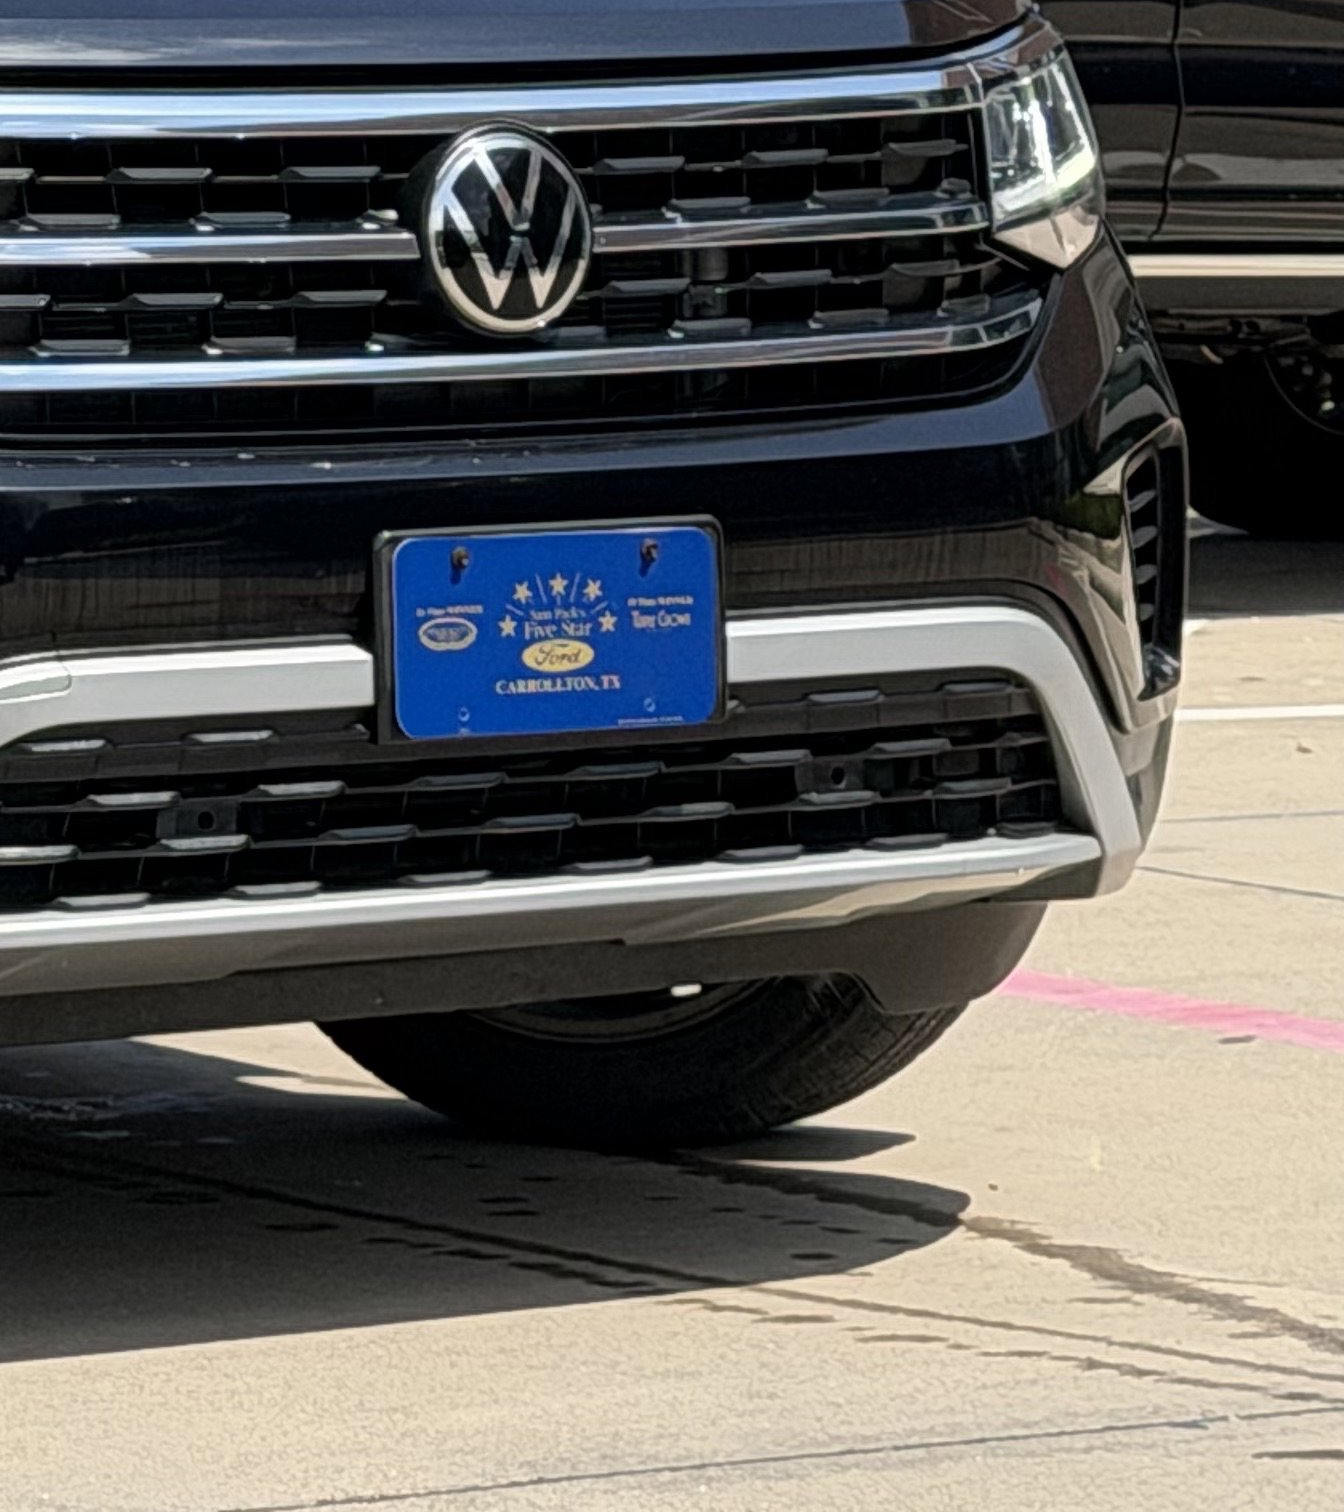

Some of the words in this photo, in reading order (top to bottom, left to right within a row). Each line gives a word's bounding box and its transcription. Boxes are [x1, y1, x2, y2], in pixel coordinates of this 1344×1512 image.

[430, 130, 592, 334] VW
[524, 620, 557, 640] Five
[561, 619, 592, 637] Star
[533, 643, 583, 667] Ford
[601, 674, 621, 690] TX
